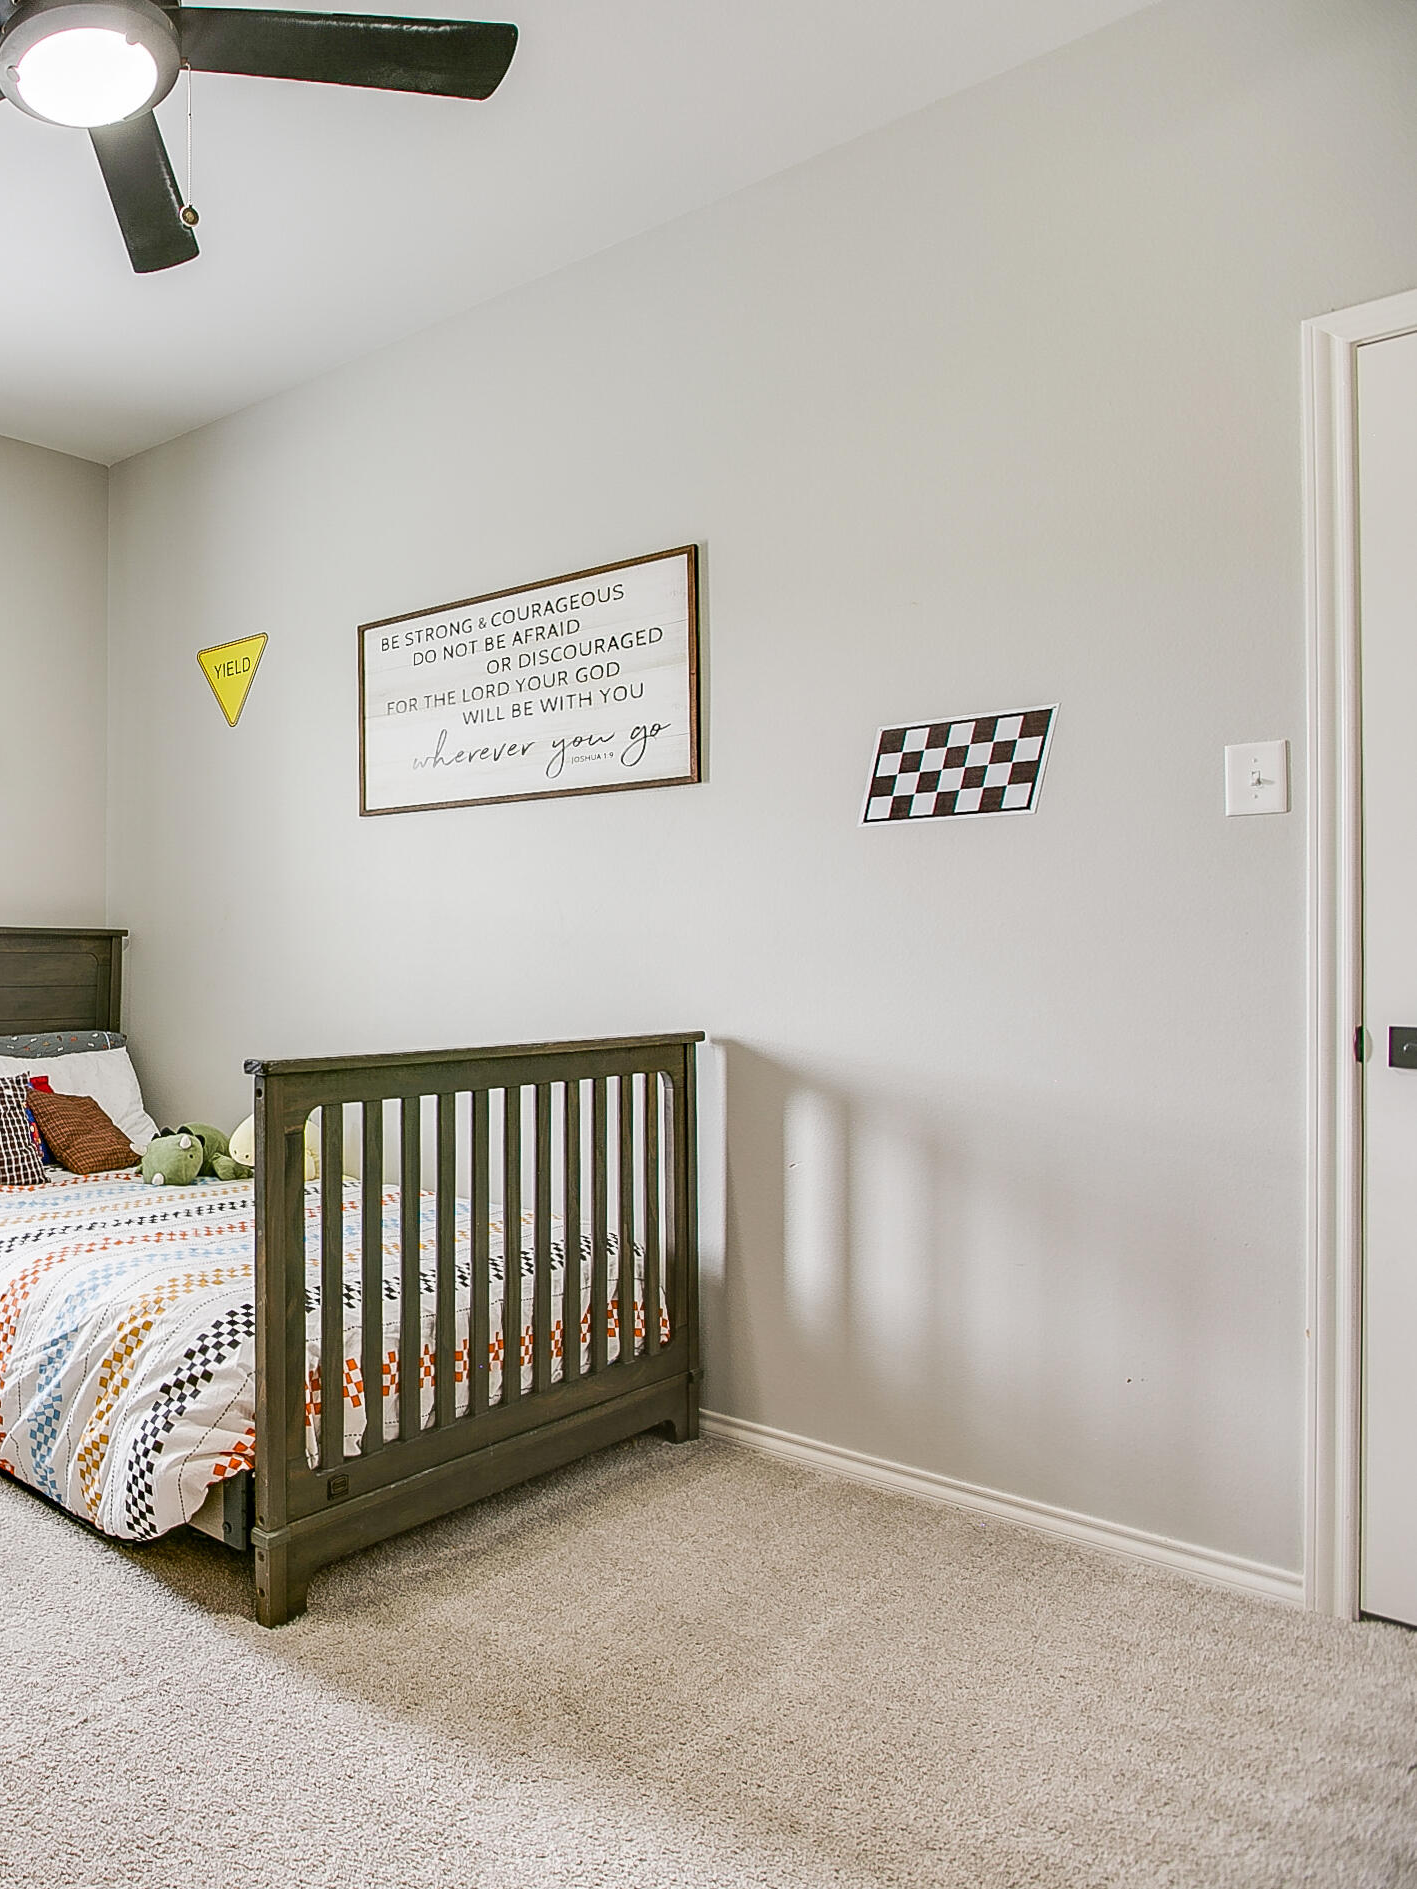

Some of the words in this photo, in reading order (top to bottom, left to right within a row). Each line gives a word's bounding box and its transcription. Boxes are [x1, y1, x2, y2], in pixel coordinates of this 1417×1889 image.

[381, 635, 400, 651] BE
[405, 618, 472, 647] STRONG
[478, 617, 487, 630] &
[491, 584, 625, 628] COURAGEOUS
[413, 649, 437, 666] DO
[443, 640, 478, 660] NOT
[485, 634, 506, 652] BE
[512, 619, 580, 646] AFRAID
[486, 656, 511, 674] OR
[518, 627, 663, 669] DISCOURAGED
[214, 656, 251, 680] YIELD
[386, 697, 418, 716] FOR
[424, 690, 456, 709] THE
[462, 681, 510, 703] LORD
[515, 670, 568, 693] YOUR
[575, 661, 620, 684] GOD
[462, 706, 505, 725] WILL
[512, 700, 533, 718] BE
[540, 691, 592, 713] WITH
[599, 682, 644, 704] YOU
[412, 729, 536, 770] wherever
[545, 732, 615, 779] you
[620, 722, 671, 767] go
[571, 753, 602, 764] JOSHUA
[603, 751, 614, 760] 1:9
